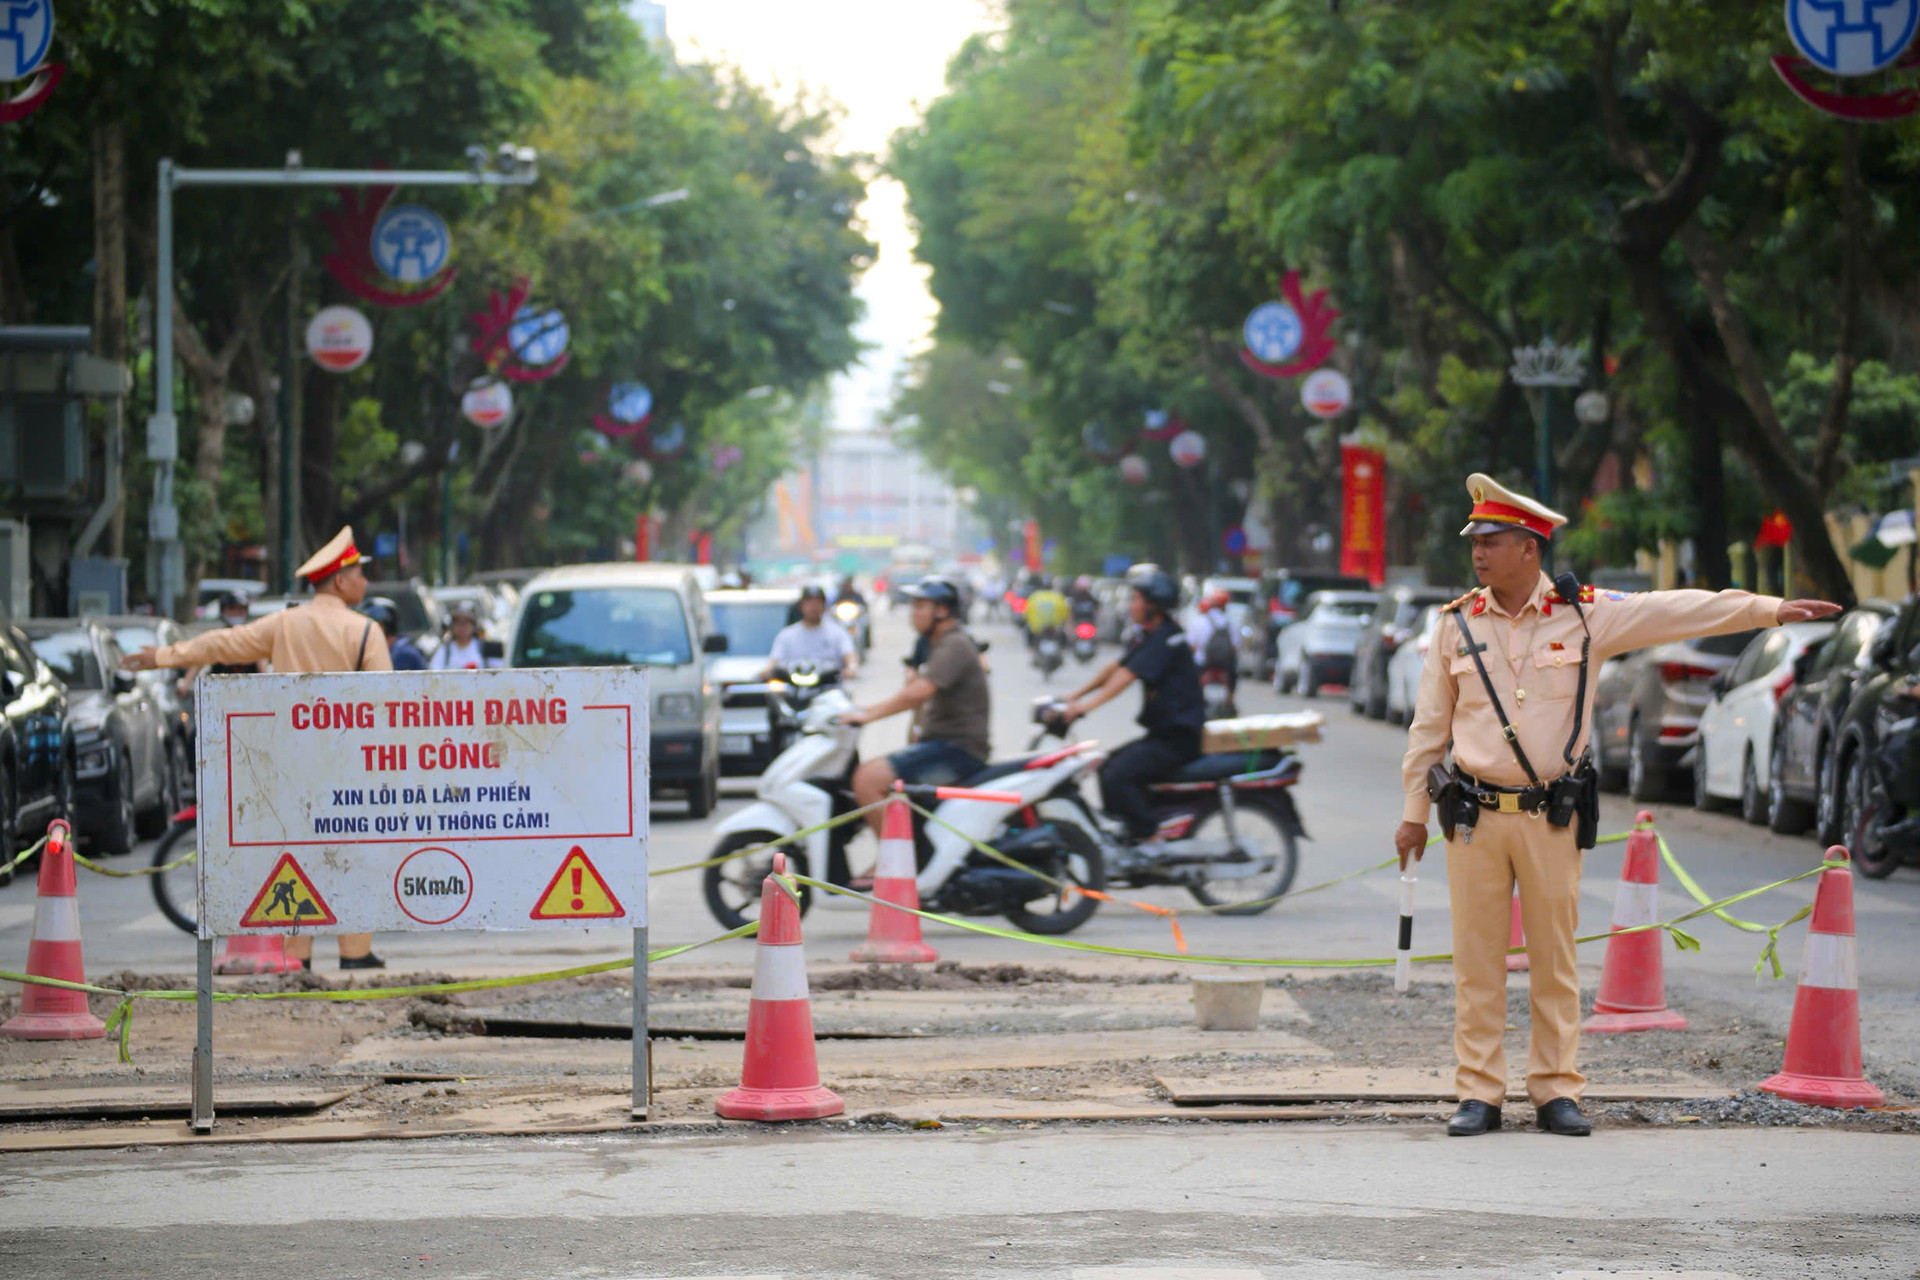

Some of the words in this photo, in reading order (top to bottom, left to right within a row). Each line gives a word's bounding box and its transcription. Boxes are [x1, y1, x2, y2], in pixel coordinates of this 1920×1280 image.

[291, 697, 375, 729] CÔNG
[384, 695, 474, 728] TRÌNH
[484, 698, 567, 726] ĐANG
[360, 744, 407, 771] THI
[418, 737, 501, 770] CÔNG
[332, 789, 363, 806] XIN
[402, 784, 427, 804] ĐÃ
[432, 783, 471, 803] LÀM
[314, 816, 369, 834] MONG
[375, 812, 409, 834] QUÝ
[415, 815, 432, 835] VỊ
[437, 810, 497, 831] THÔNG
[502, 807, 550, 829] CẢM!
[404, 875, 464, 896] 5Km/h
